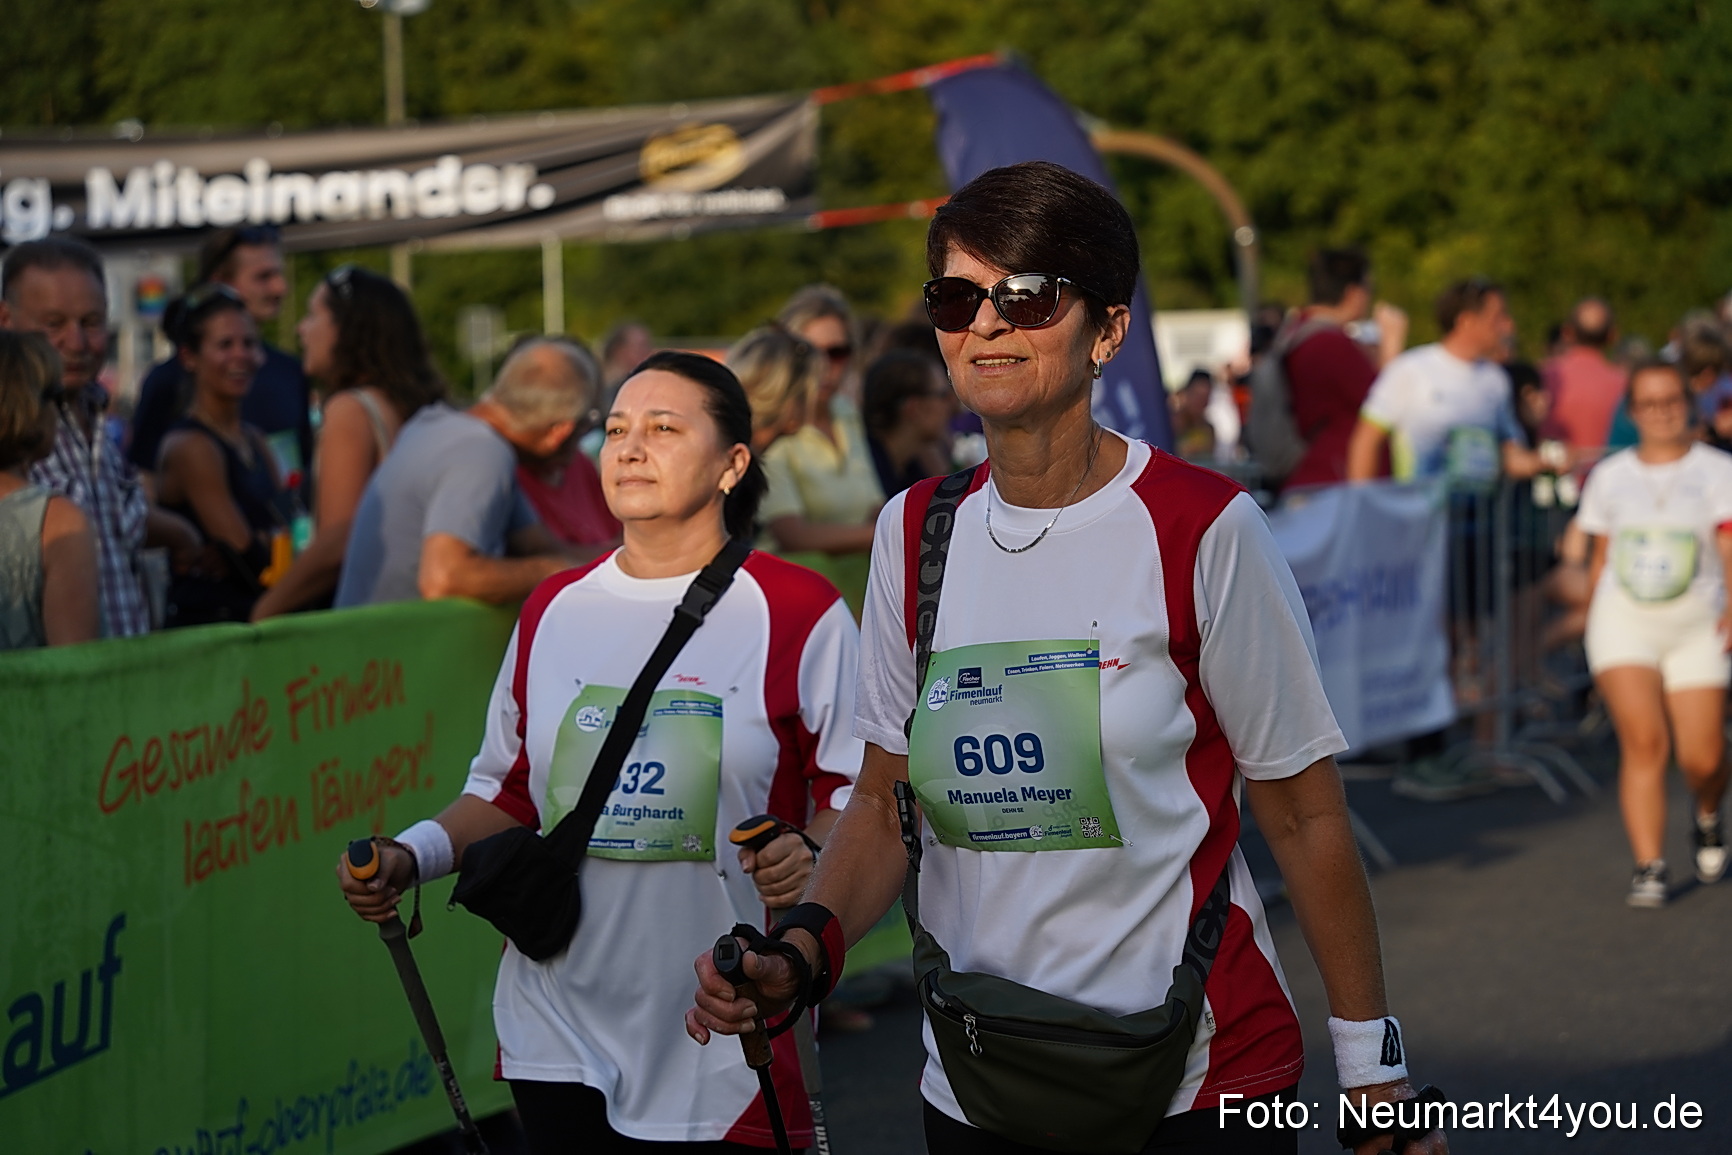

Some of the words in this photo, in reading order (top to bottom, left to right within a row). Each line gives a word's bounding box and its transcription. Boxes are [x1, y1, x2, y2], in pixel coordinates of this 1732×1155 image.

[1, 176, 75, 247] g.
[85, 154, 556, 230] Miteinander.
[950, 684, 1003, 701] Firmenlauf
[970, 696, 1003, 706] neumarkt
[98, 678, 273, 815] Gesunde
[286, 658, 407, 745] Firmen
[953, 732, 1045, 777] 609
[183, 778, 303, 889] laufen
[310, 709, 435, 837] länger!
[612, 803, 684, 820] Burghardt
[947, 788, 1019, 806] Manuela
[1020, 786, 1072, 806] Meyer
[972, 831, 1028, 841] firmenlauf.bayern
[0, 911, 126, 1098] auf
